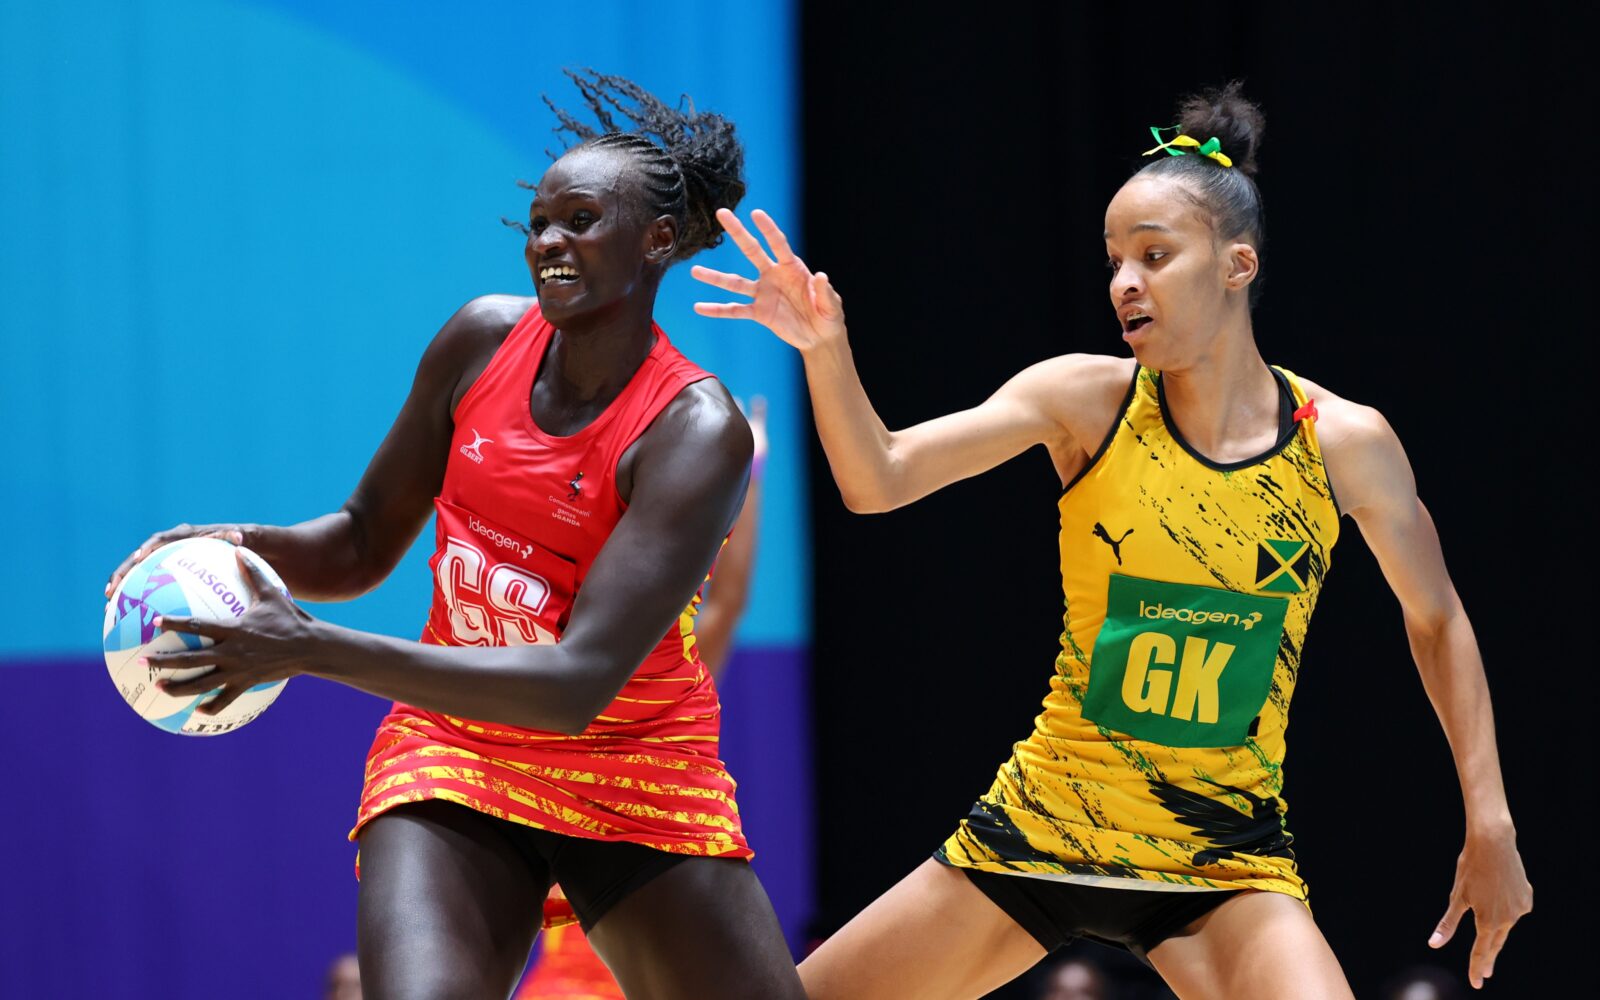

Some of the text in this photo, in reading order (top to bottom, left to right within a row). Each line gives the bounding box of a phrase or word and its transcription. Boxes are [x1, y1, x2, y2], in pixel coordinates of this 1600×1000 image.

[460, 446, 484, 464] GILBERT
[468, 515, 521, 554] Ideagen
[551, 512, 581, 527] UGANDA
[177, 558, 246, 618] GLASGOW
[436, 535, 557, 647] GS
[1139, 600, 1240, 626] Ideagen
[1121, 631, 1236, 724] GK
